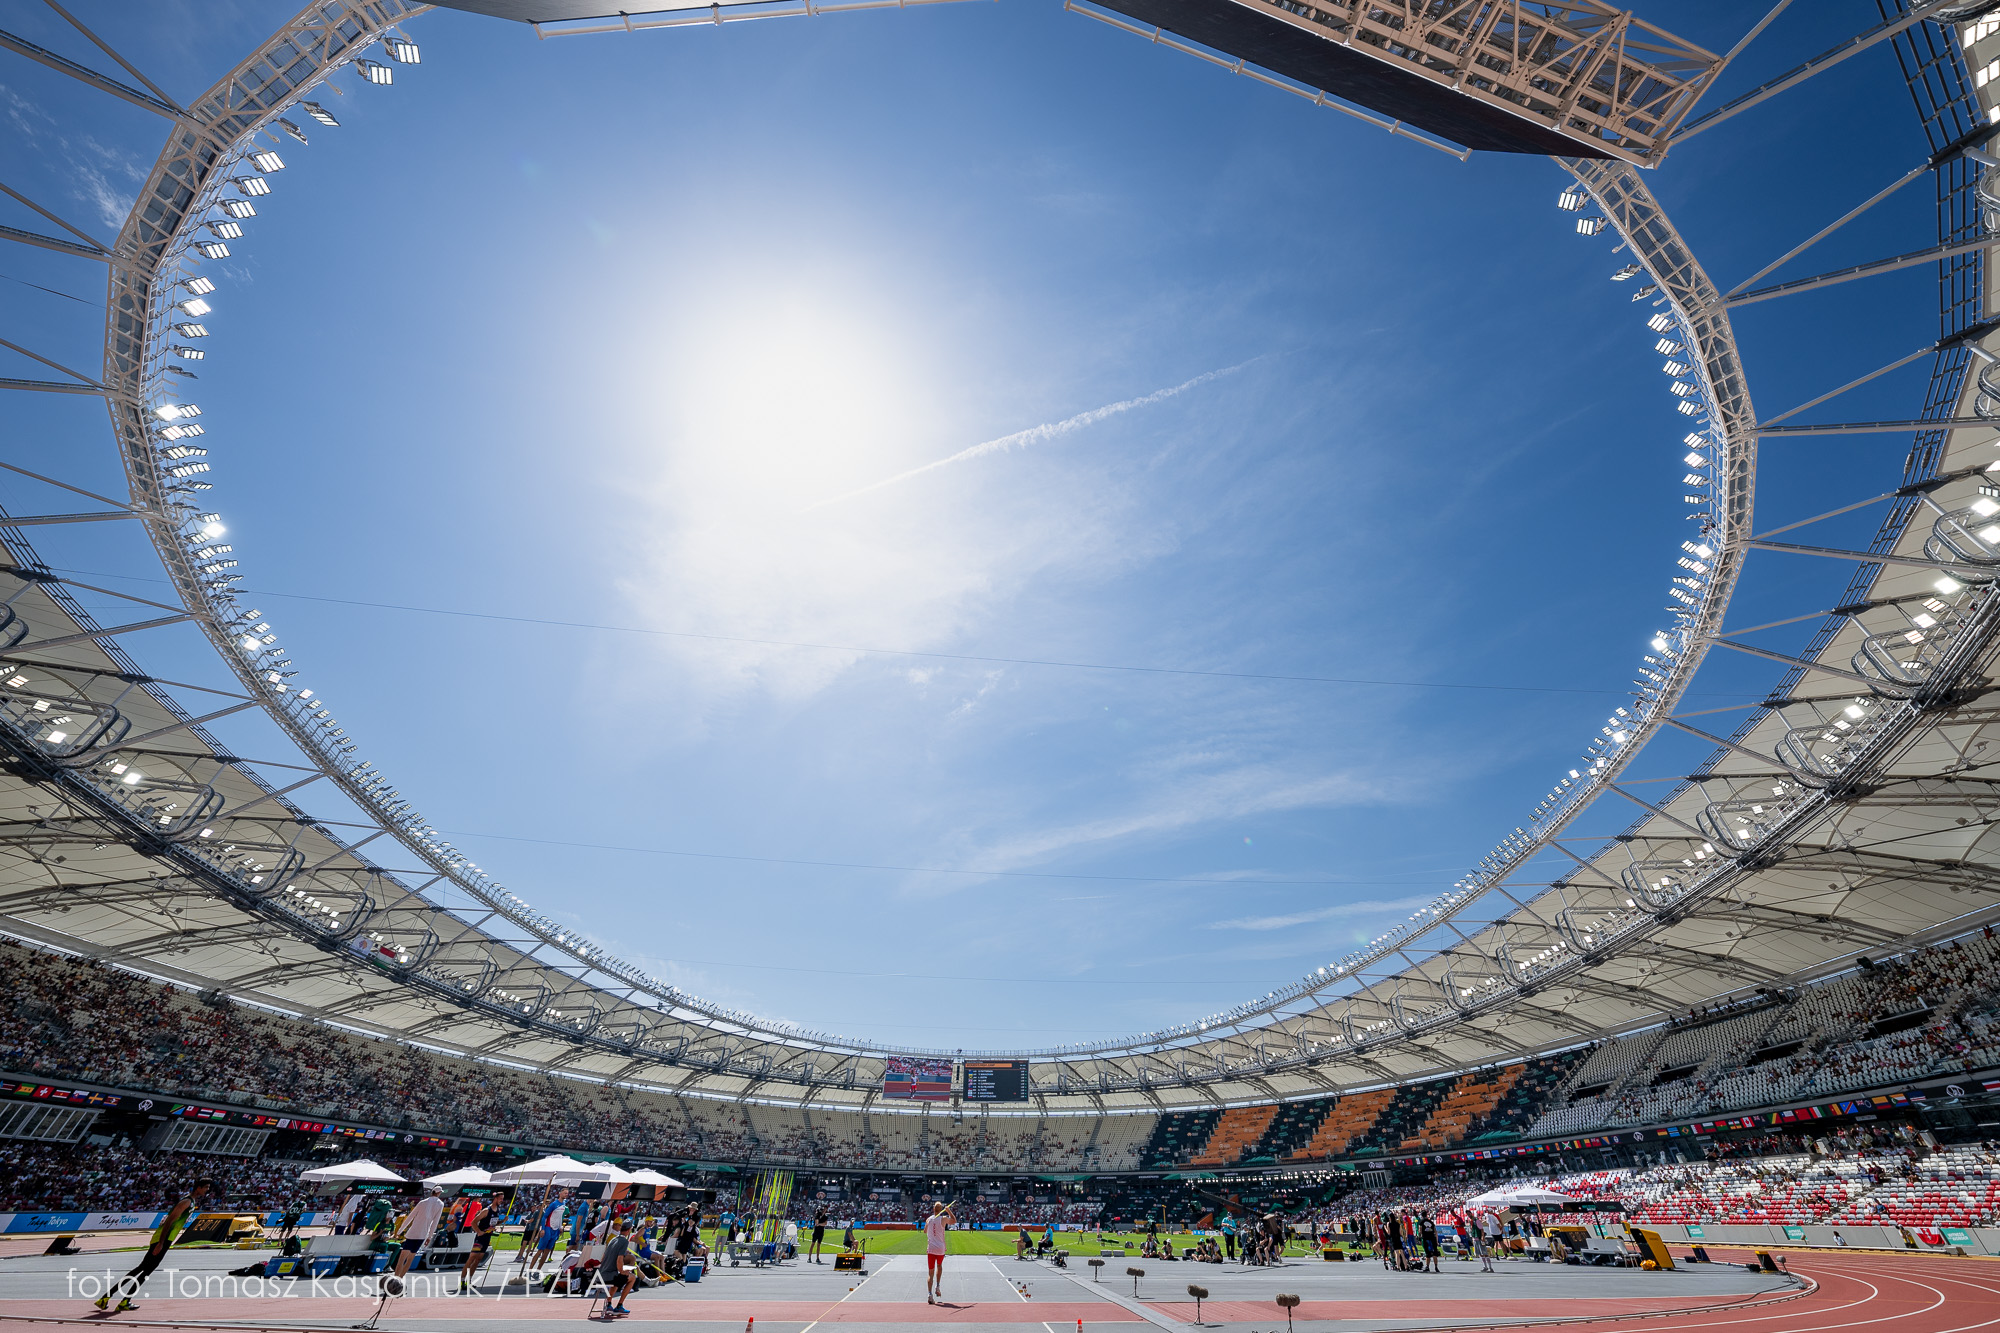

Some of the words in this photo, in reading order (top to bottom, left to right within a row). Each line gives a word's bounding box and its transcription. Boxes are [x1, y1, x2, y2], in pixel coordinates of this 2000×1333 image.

[27, 1215, 48, 1231] Tokyo
[47, 1215, 69, 1228] Tokyo
[99, 1215, 119, 1229] Tokyo
[119, 1215, 139, 1226] Tokyo
